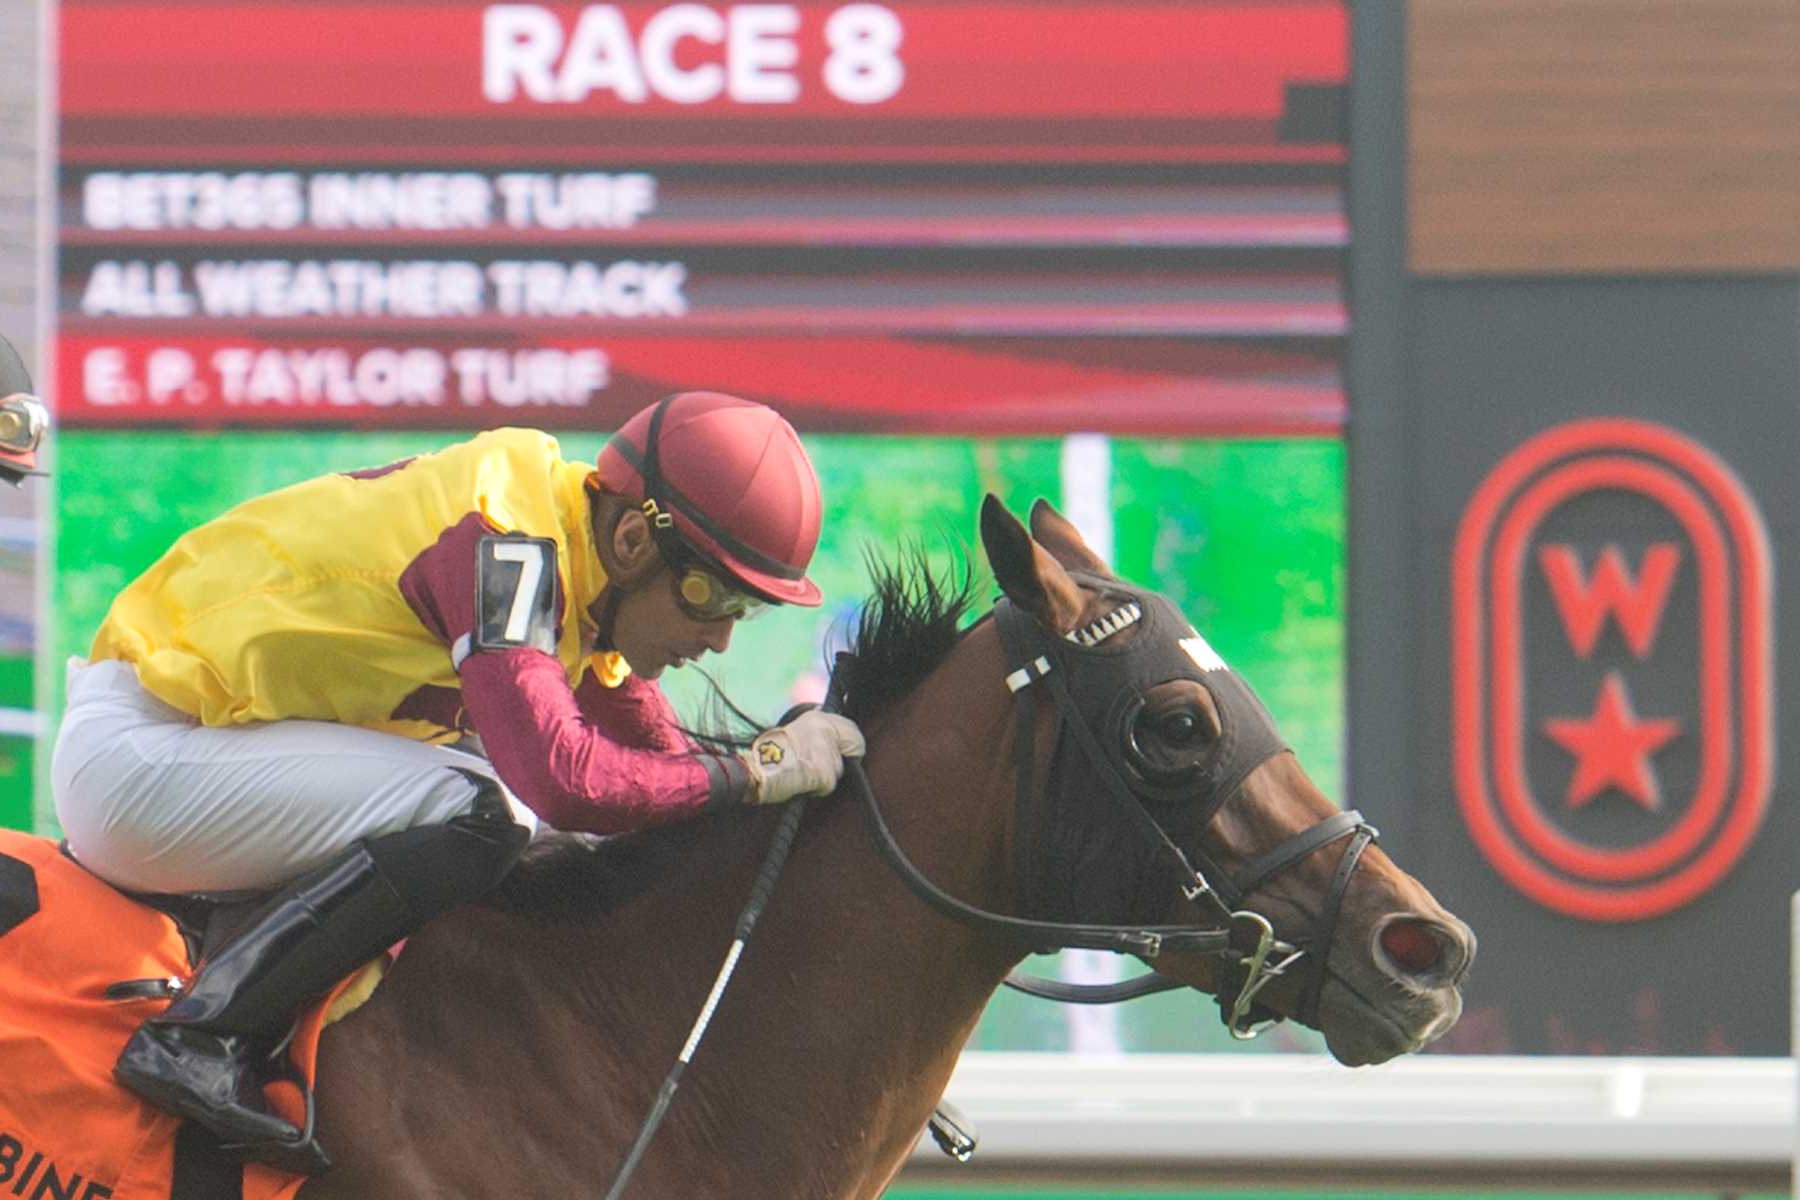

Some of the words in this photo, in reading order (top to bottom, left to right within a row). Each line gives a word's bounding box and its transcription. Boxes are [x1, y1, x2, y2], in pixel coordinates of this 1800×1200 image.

[482, 4, 800, 103] RACE
[824, 4, 903, 103] 8
[83, 173, 304, 230] BET365
[308, 173, 492, 230] INNER
[498, 173, 654, 230] TURF
[81, 260, 195, 317] ALL
[194, 260, 484, 317] WEATHER
[488, 260, 687, 317] TRACK
[83, 348, 141, 406] E.
[147, 348, 208, 406] P.
[212, 348, 446, 406] TAYLOR
[452, 348, 607, 406] TURF
[493, 543, 544, 641] 7
[1539, 543, 1679, 662] W
